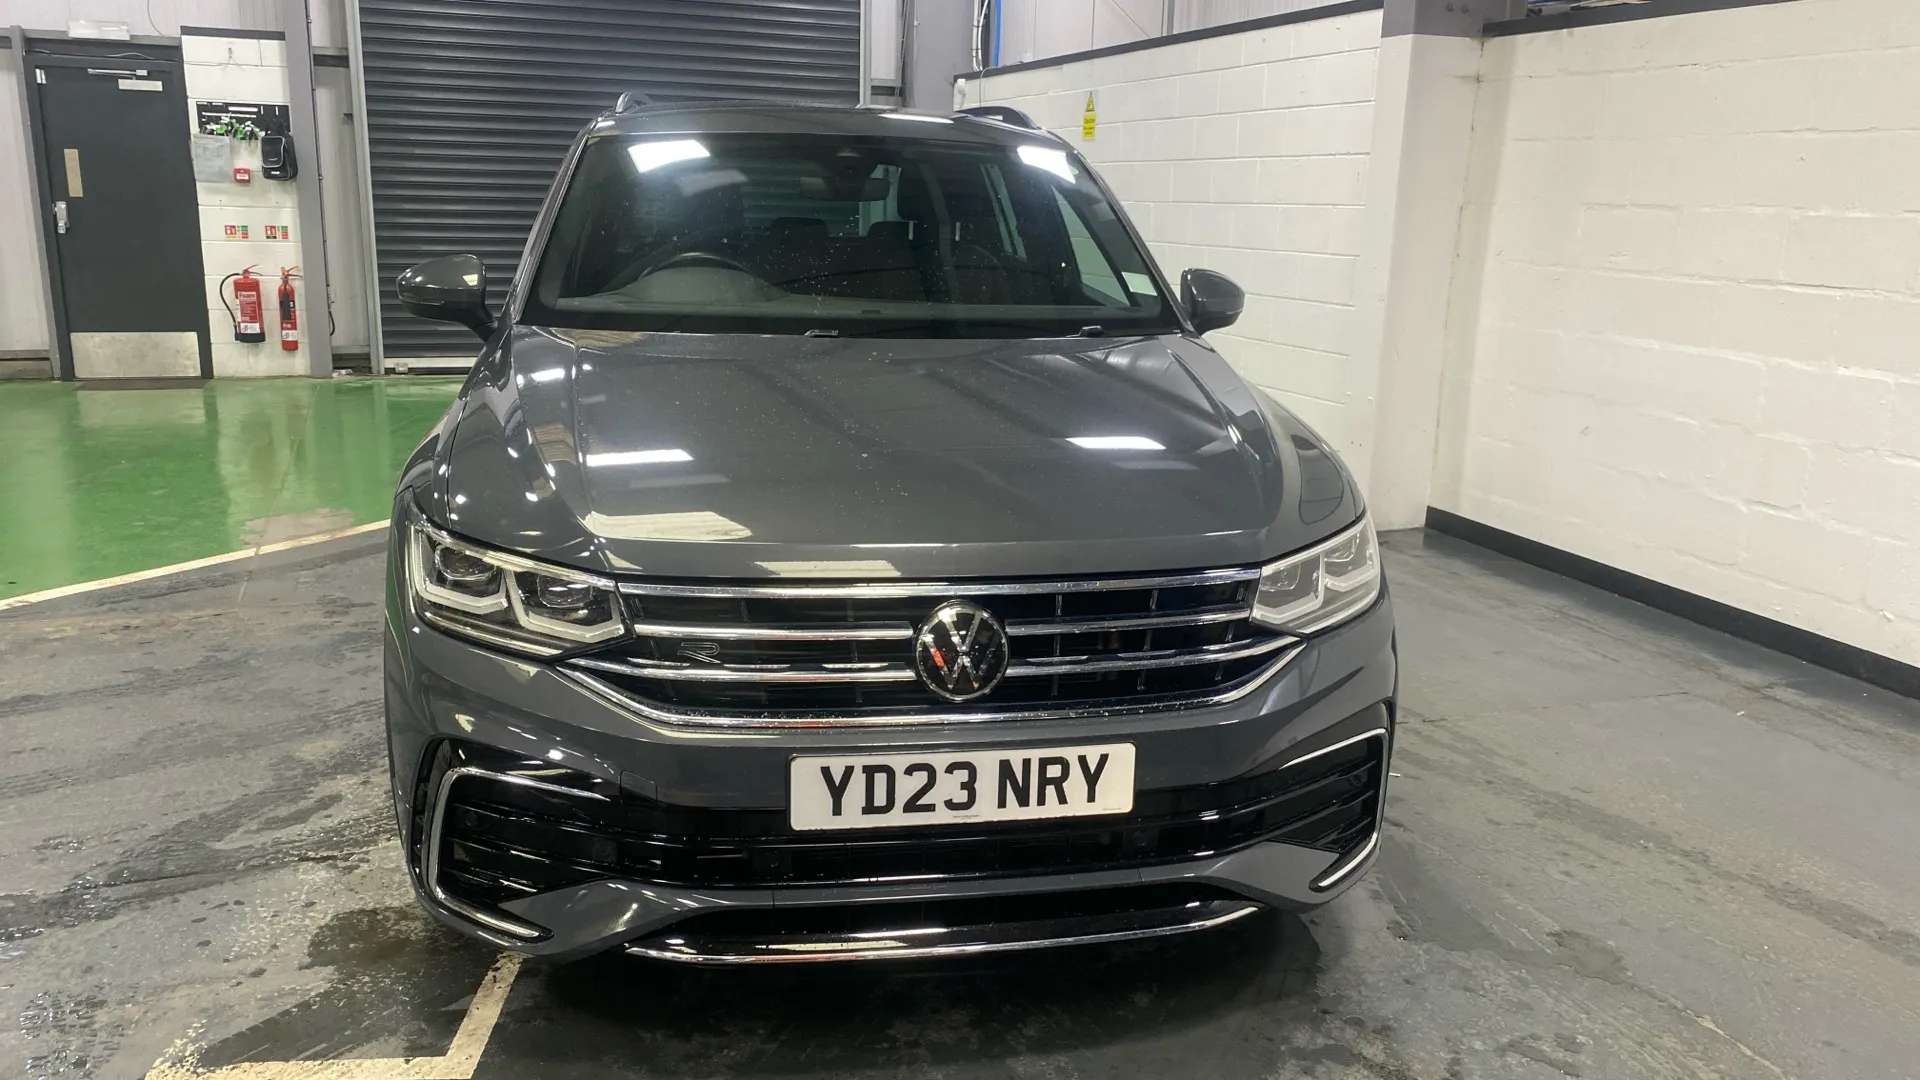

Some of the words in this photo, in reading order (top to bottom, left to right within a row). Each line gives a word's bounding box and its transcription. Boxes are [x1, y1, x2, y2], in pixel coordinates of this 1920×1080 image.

[677, 641, 721, 664] R
[820, 761, 977, 817] YD23
[997, 753, 1110, 809] NRY
